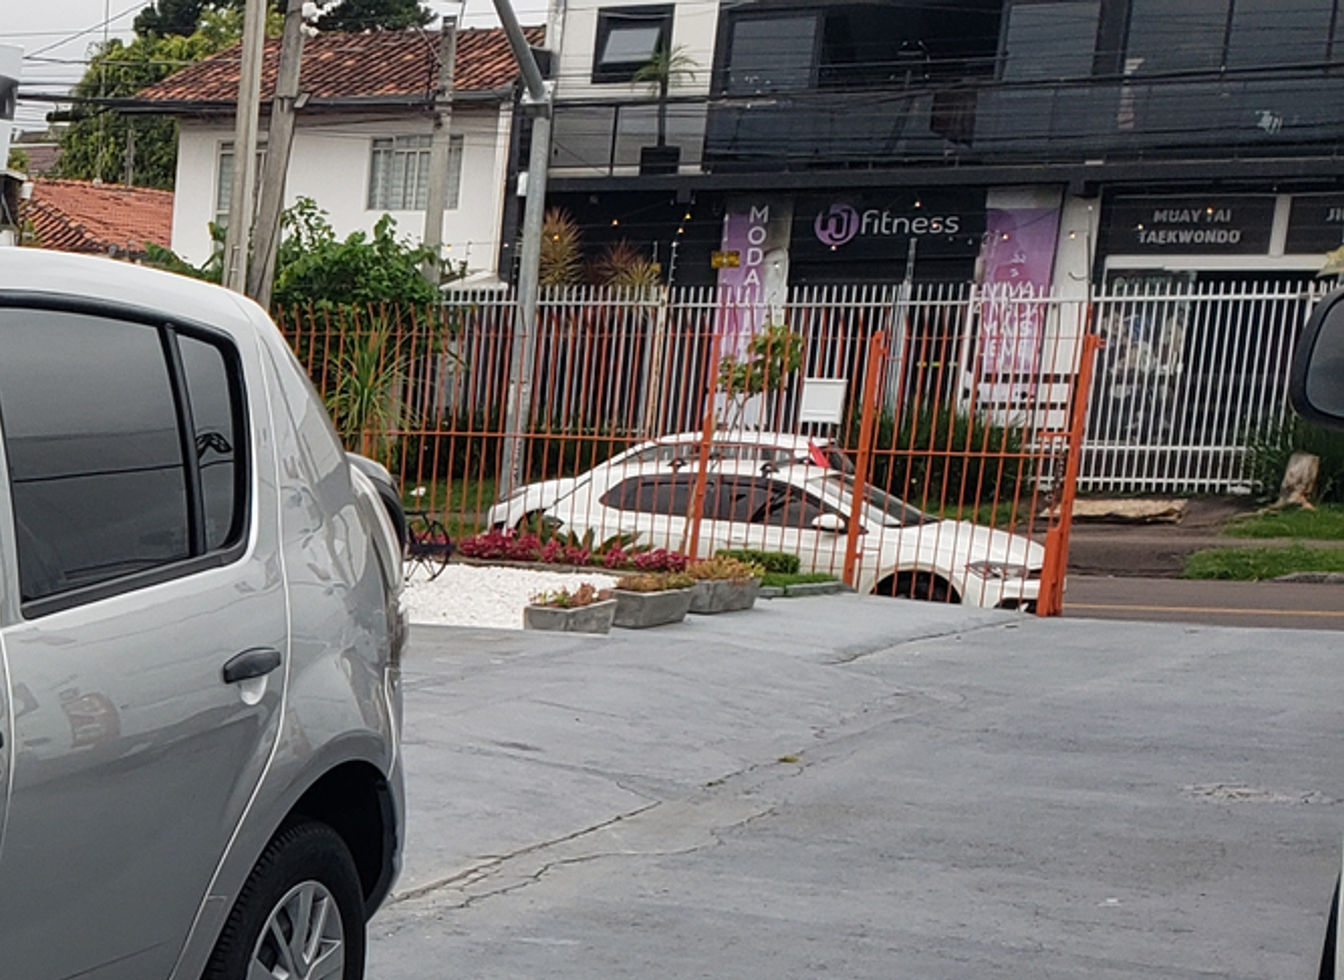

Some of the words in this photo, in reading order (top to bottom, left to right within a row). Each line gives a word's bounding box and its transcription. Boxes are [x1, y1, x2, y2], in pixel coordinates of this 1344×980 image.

[861, 209, 960, 236] fitness
[1153, 208, 1202, 223] MUAY
[743, 205, 769, 286] MODA
[1138, 228, 1242, 244] TAEKWONDO
